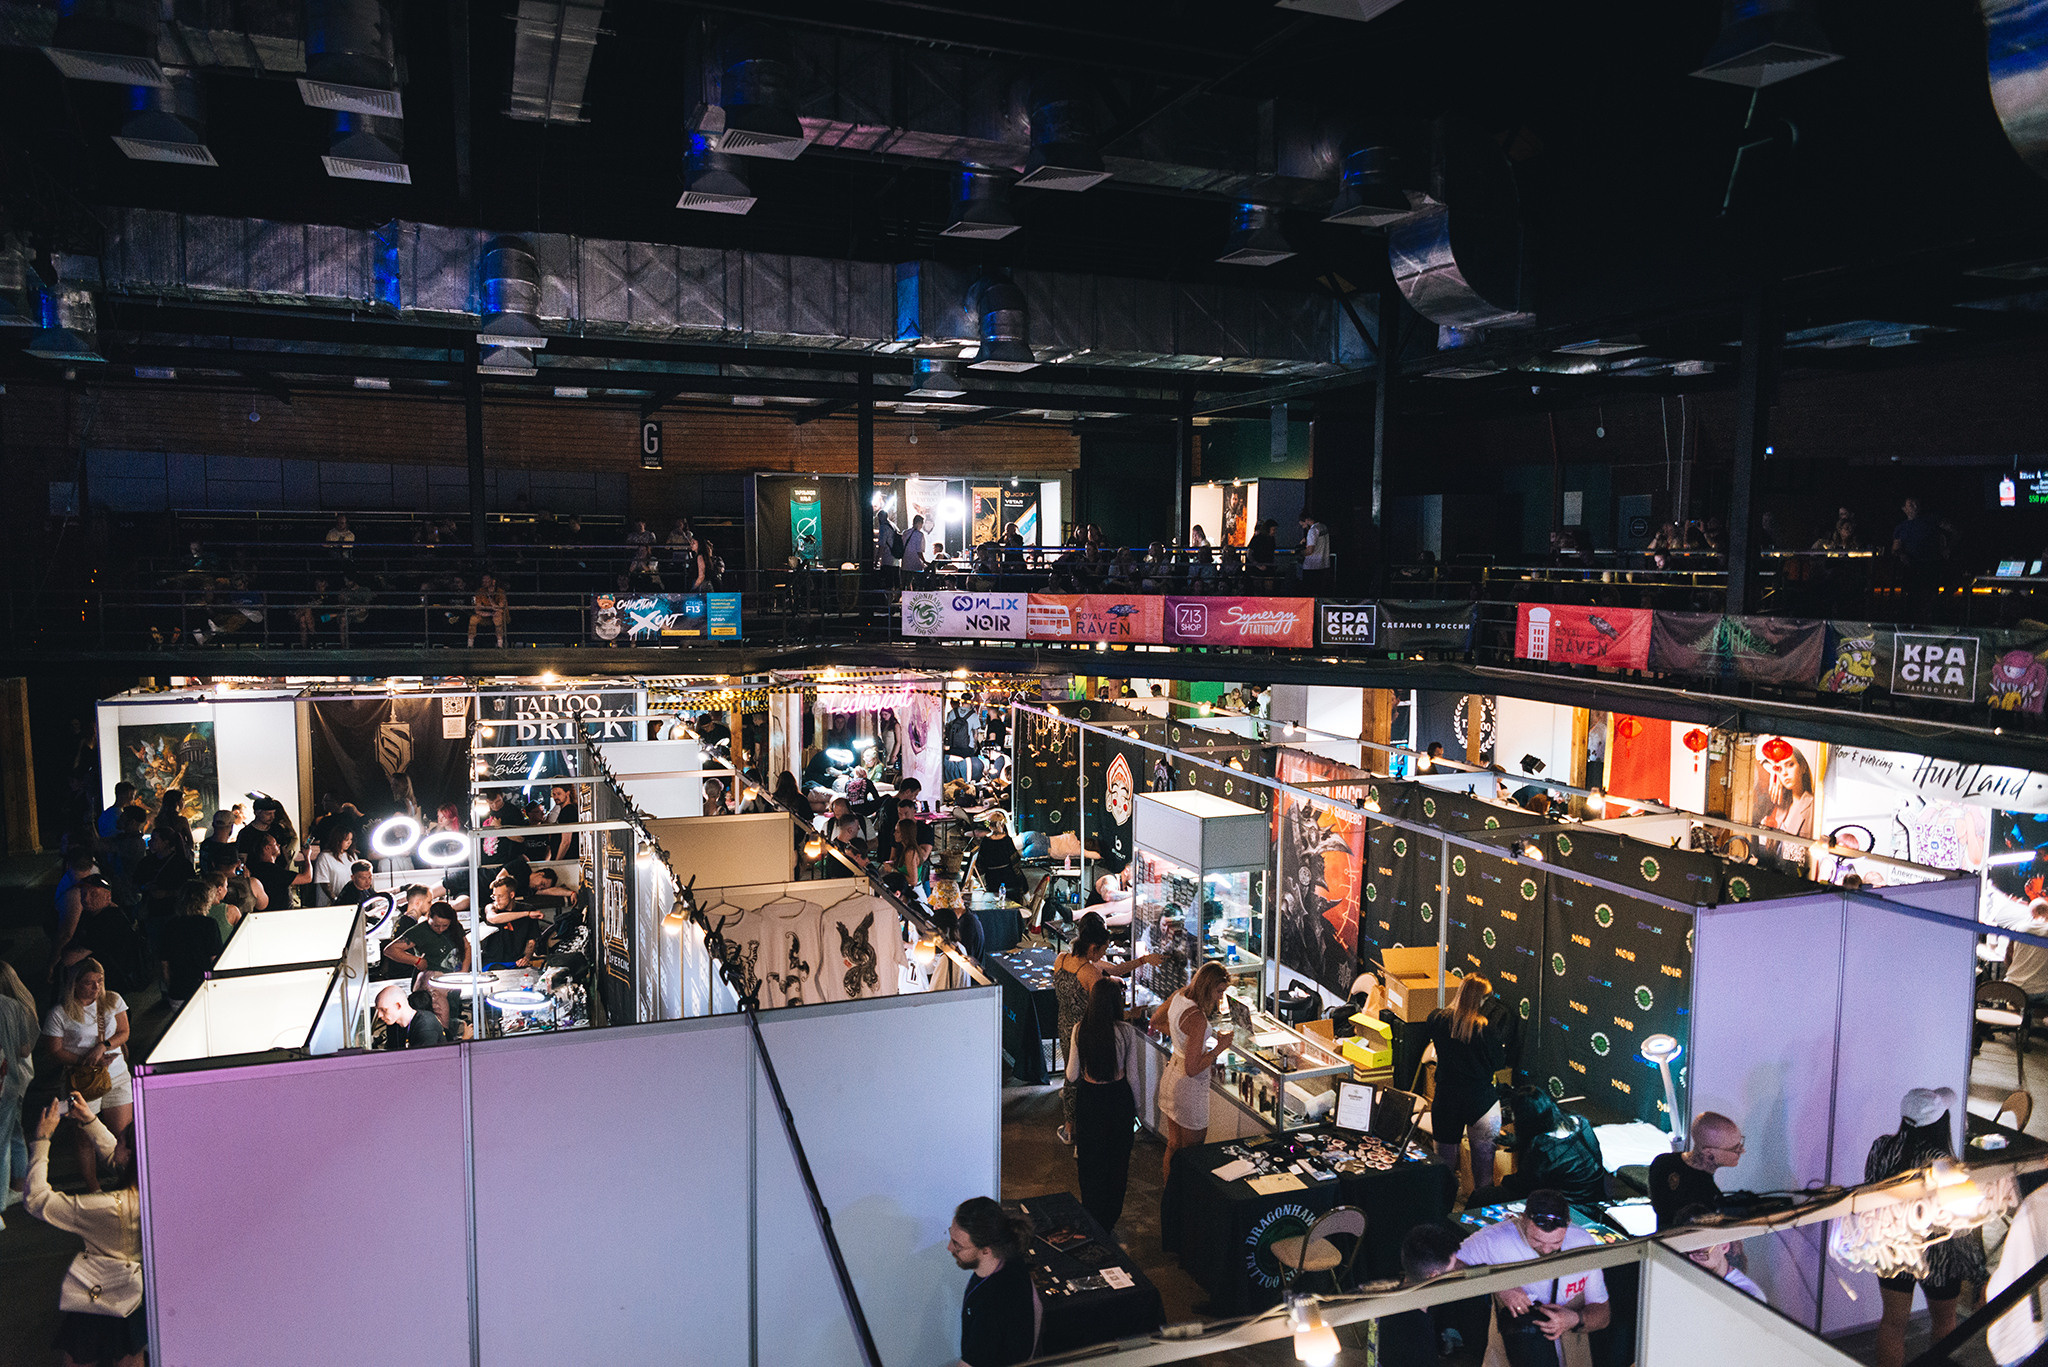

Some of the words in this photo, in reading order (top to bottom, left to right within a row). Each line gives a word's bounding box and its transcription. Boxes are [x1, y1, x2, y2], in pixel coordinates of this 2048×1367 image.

[643, 422, 659, 455] G
[685, 605, 701, 613] F13
[1076, 612, 1102, 620] ROYAL
[1327, 611, 1369, 623] КРА
[965, 614, 1011, 632] NOIR
[1076, 621, 1130, 635] RAVEN
[1180, 624, 1202, 632] SHOP
[1220, 606, 1299, 635] Synergy
[1249, 624, 1273, 635] TATTOO
[1327, 623, 1369, 636] СКА
[1555, 628, 1581, 637] ROYAL
[1554, 638, 1608, 656] RAVEN
[1903, 644, 1967, 666] КРА
[1901, 663, 1965, 686] СКА
[1906, 685, 1939, 693] TATTOO
[514, 694, 602, 713] TATTOO
[515, 709, 627, 741] BRICK
[1461, 719, 1492, 732] TOO
[494, 761, 548, 777] Brickmn
[1859, 754, 1894, 775] piercing
[1571, 933, 1591, 948] NOIR
[1660, 963, 1682, 979] NOIR
[1245, 1203, 1317, 1247] DRAGONHAW
[1245, 1252, 1280, 1289] TATTOO
